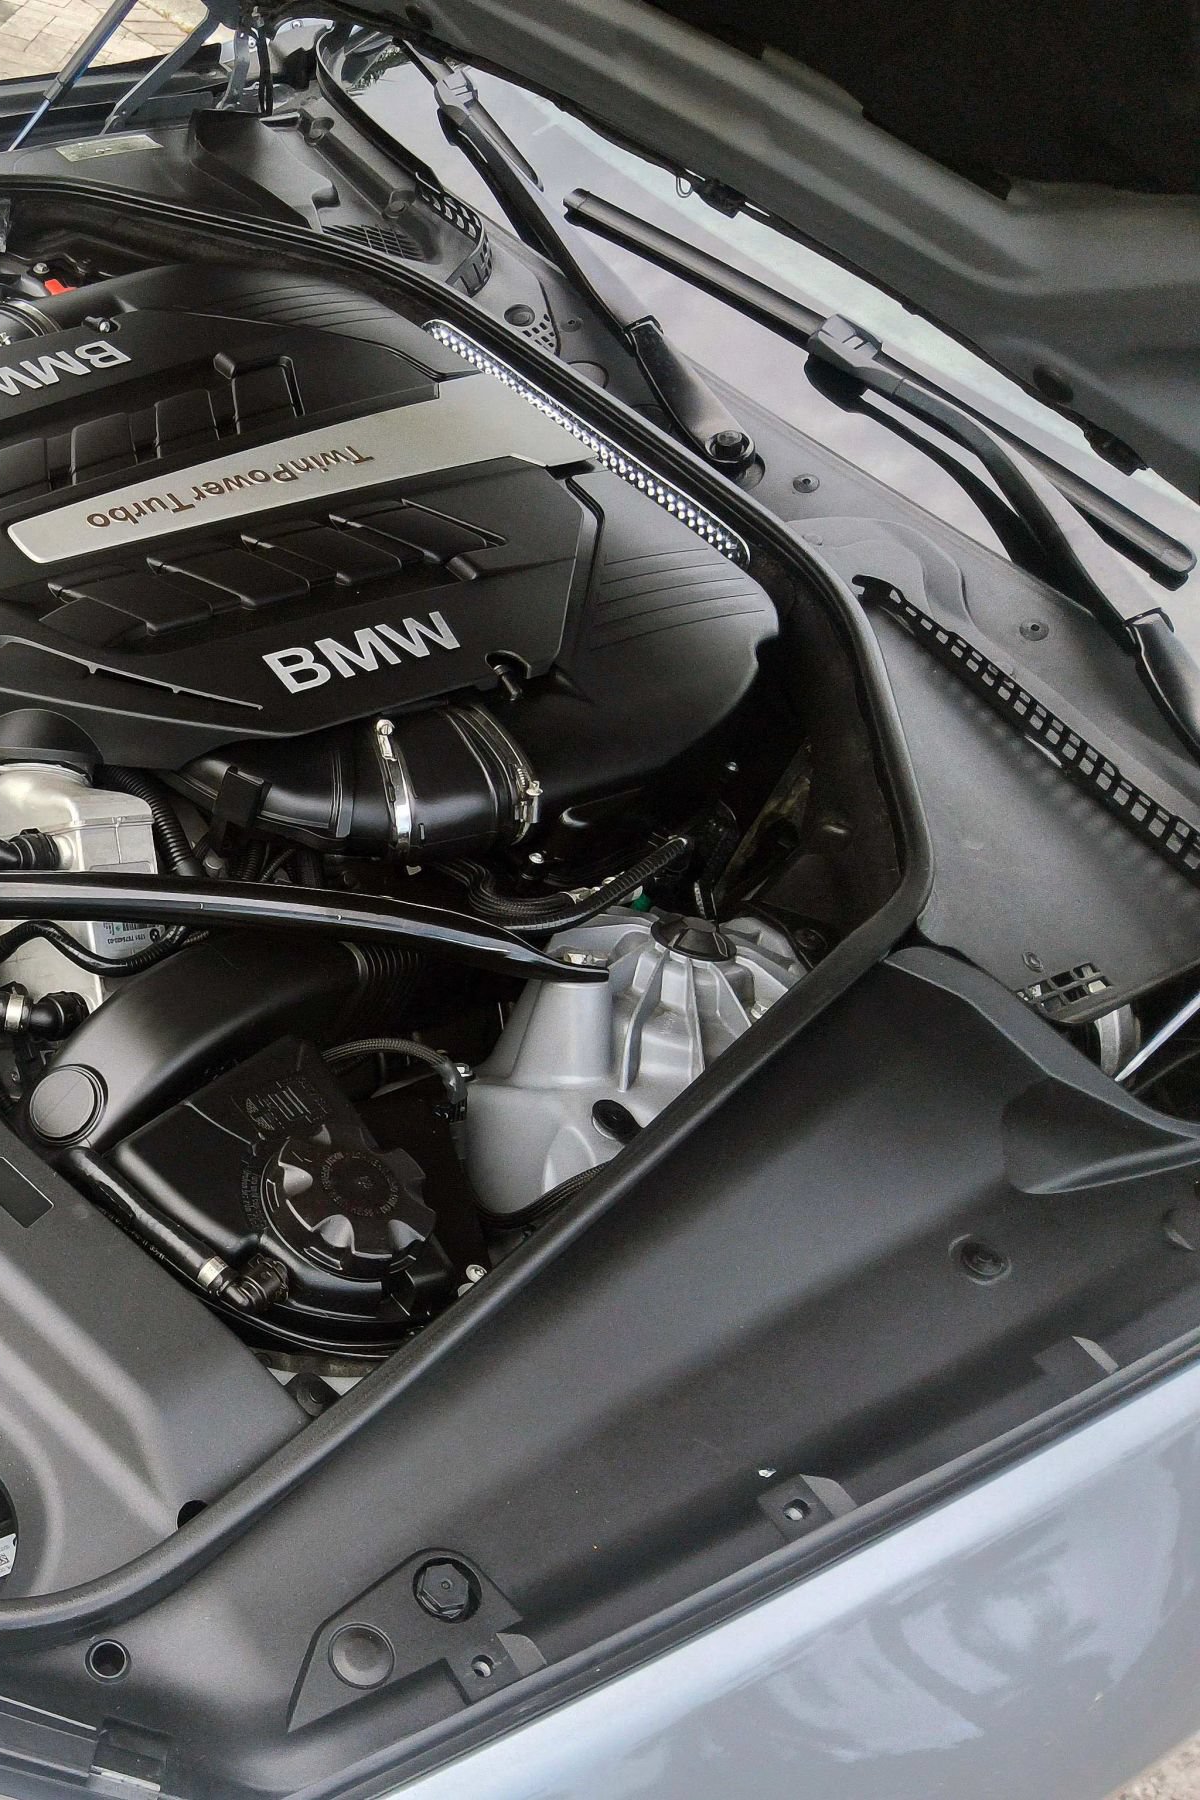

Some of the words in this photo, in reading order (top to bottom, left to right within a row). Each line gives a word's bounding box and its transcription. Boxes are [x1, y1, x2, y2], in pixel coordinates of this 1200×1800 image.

[193, 446, 374, 501] TwinPower
[86, 492, 195, 528] Turbo
[262, 611, 461, 694] BMW
